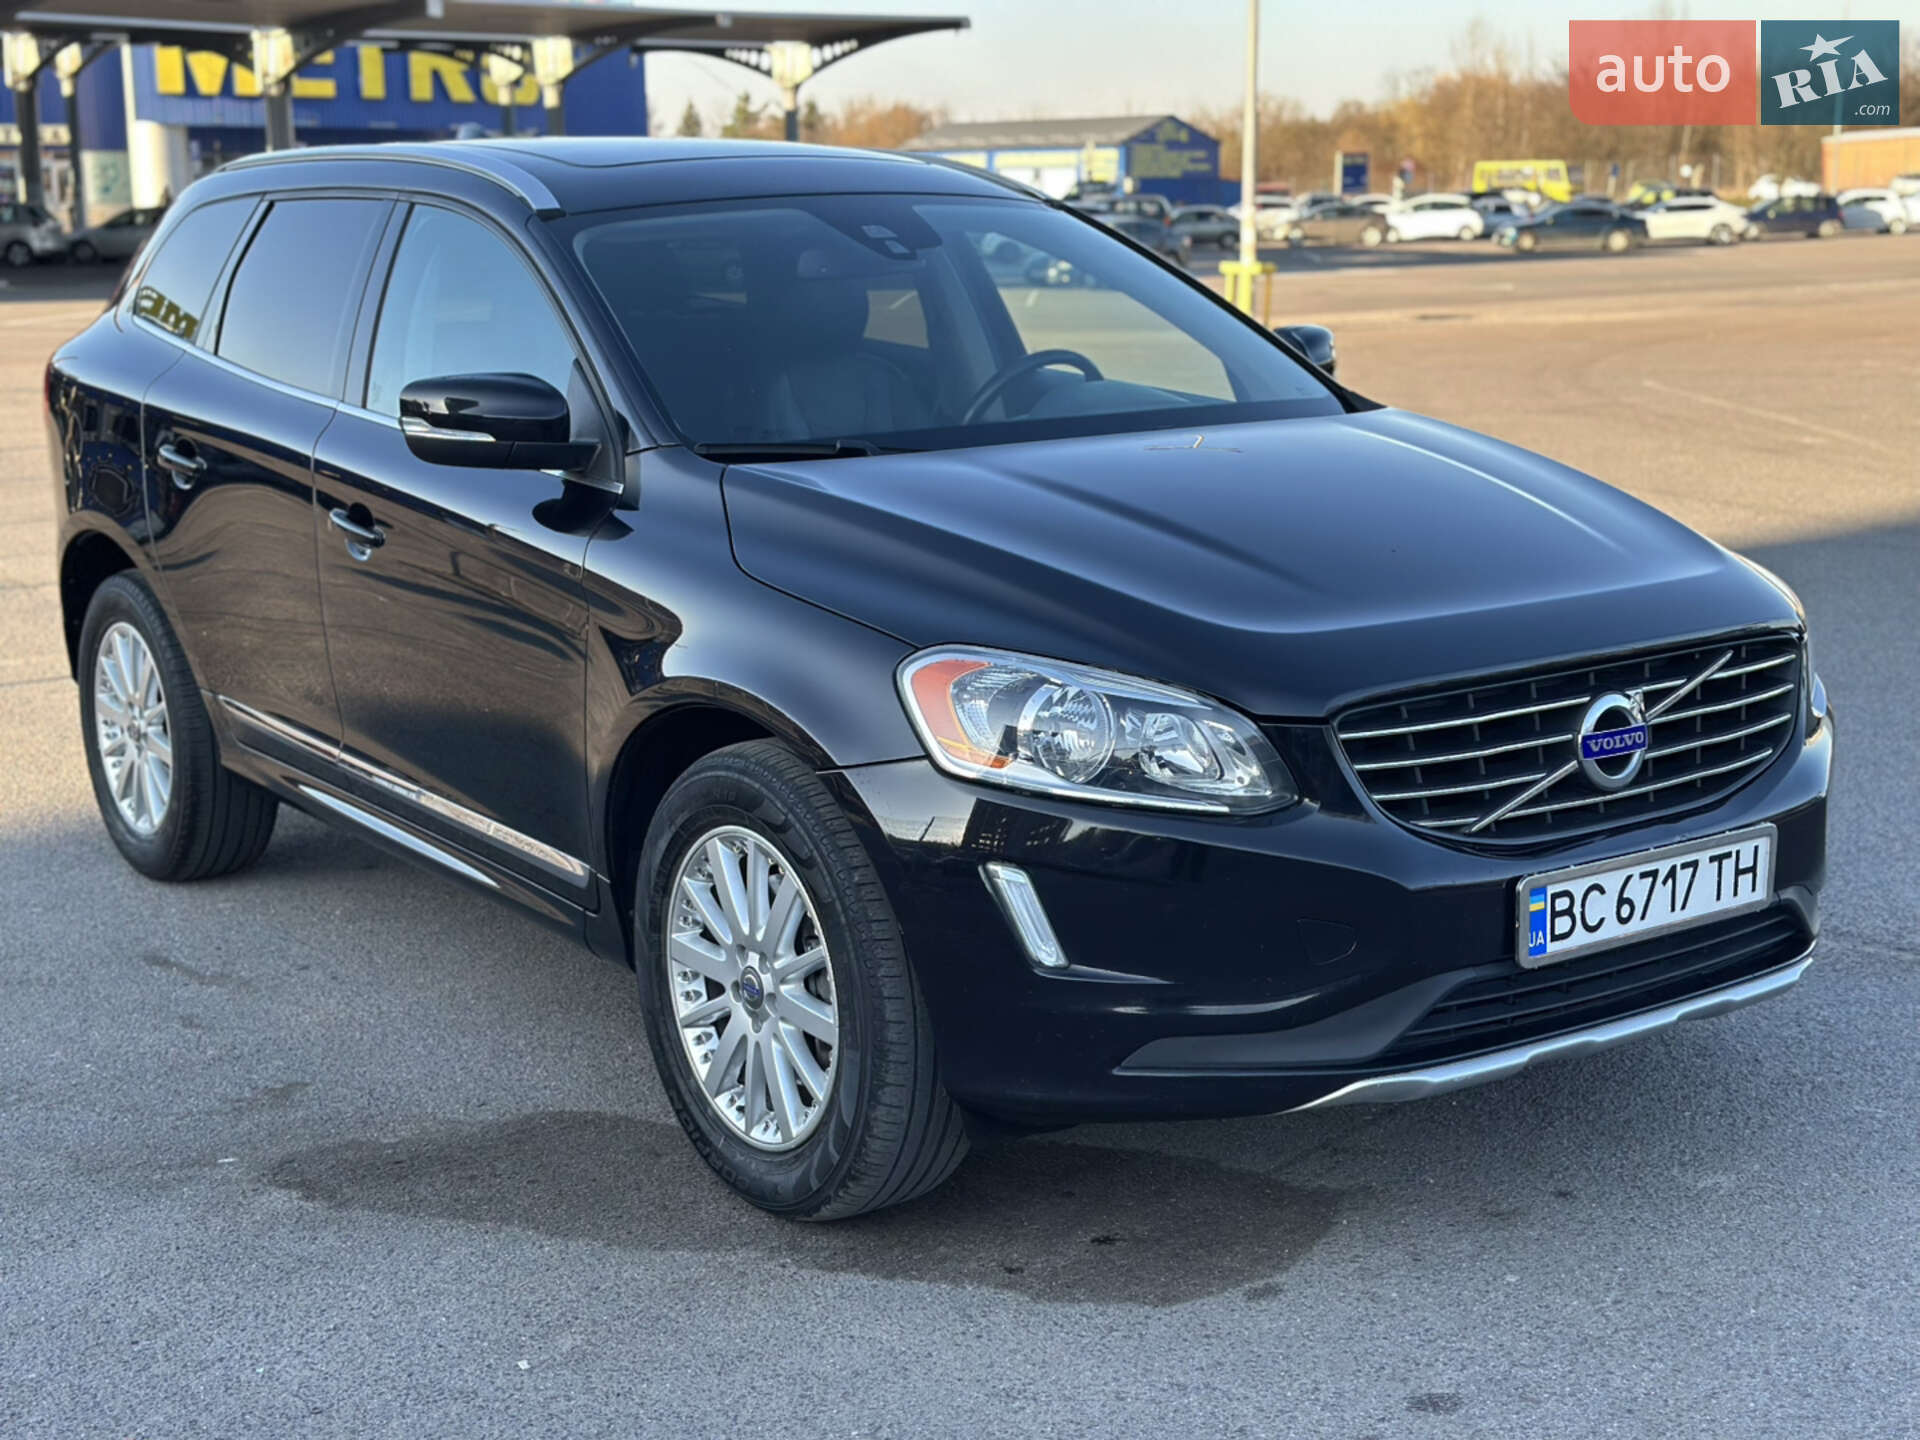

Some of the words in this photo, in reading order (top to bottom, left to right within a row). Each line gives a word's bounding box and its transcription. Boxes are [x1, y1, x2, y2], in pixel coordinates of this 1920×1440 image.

[1586, 731, 1645, 753] VOLVO
[1549, 883, 1606, 943] BC
[1615, 859, 1700, 926] 6717
[1708, 844, 1759, 902] TH
[1528, 930, 1545, 947] UA
